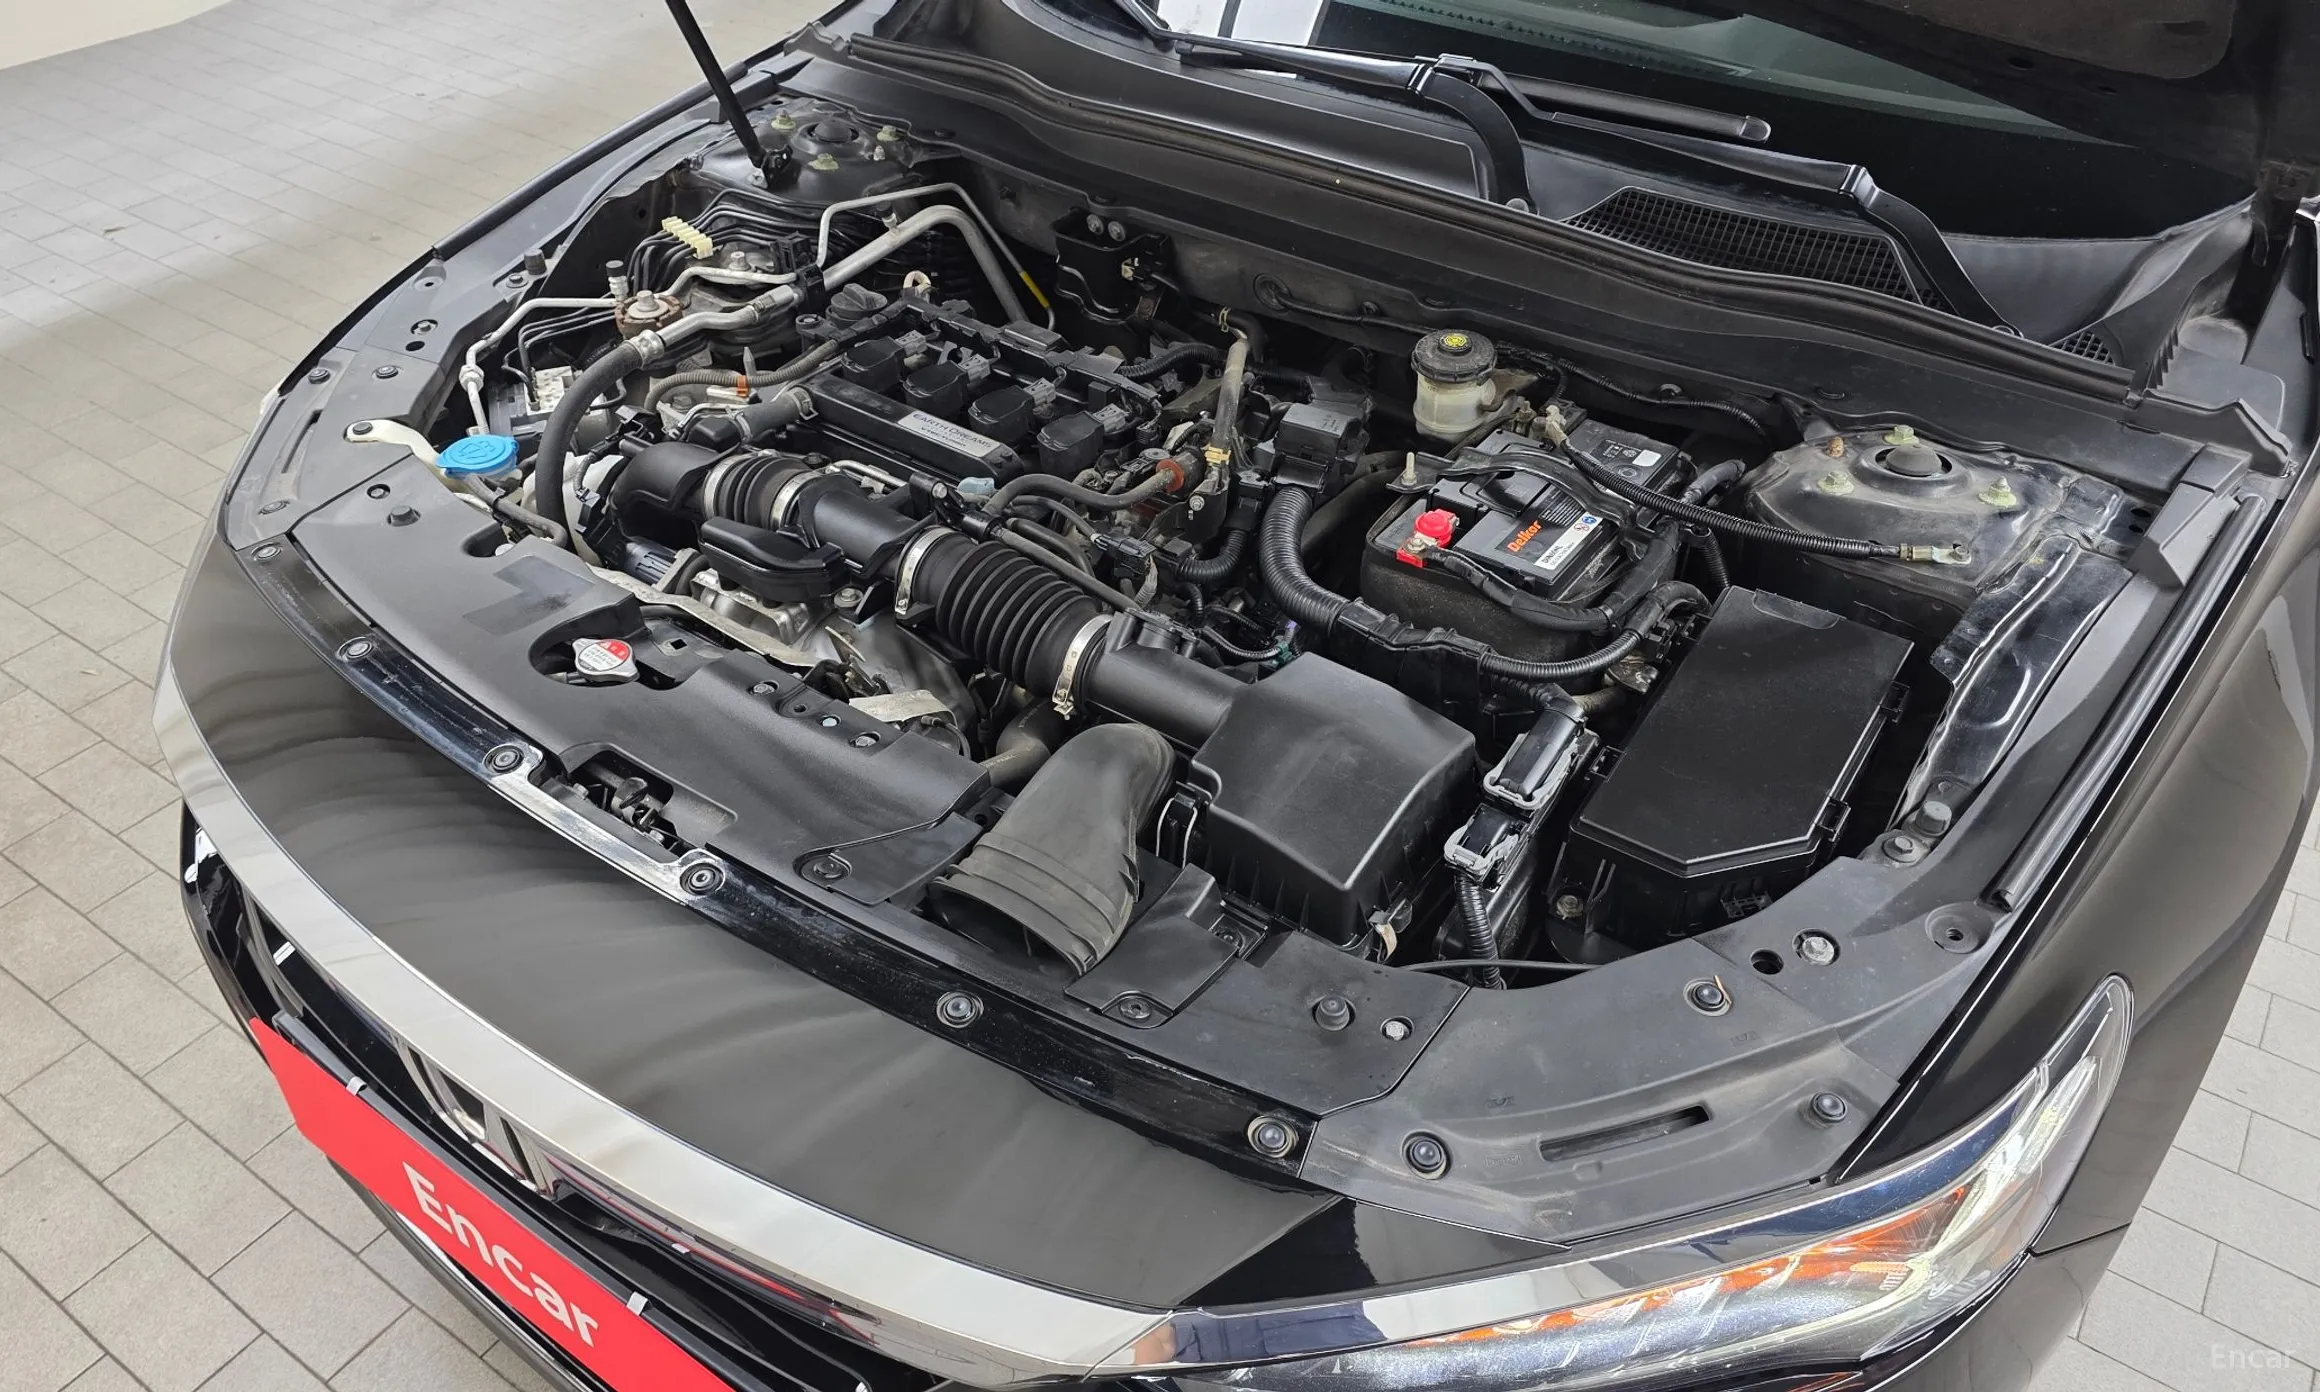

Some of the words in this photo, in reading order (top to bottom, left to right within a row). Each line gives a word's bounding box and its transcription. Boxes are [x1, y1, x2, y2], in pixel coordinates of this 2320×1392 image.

[913, 413, 948, 431] EARTH
[949, 426, 991, 448] DREAMS
[1506, 520, 1542, 552] Delkor
[402, 1161, 599, 1348] Encar
